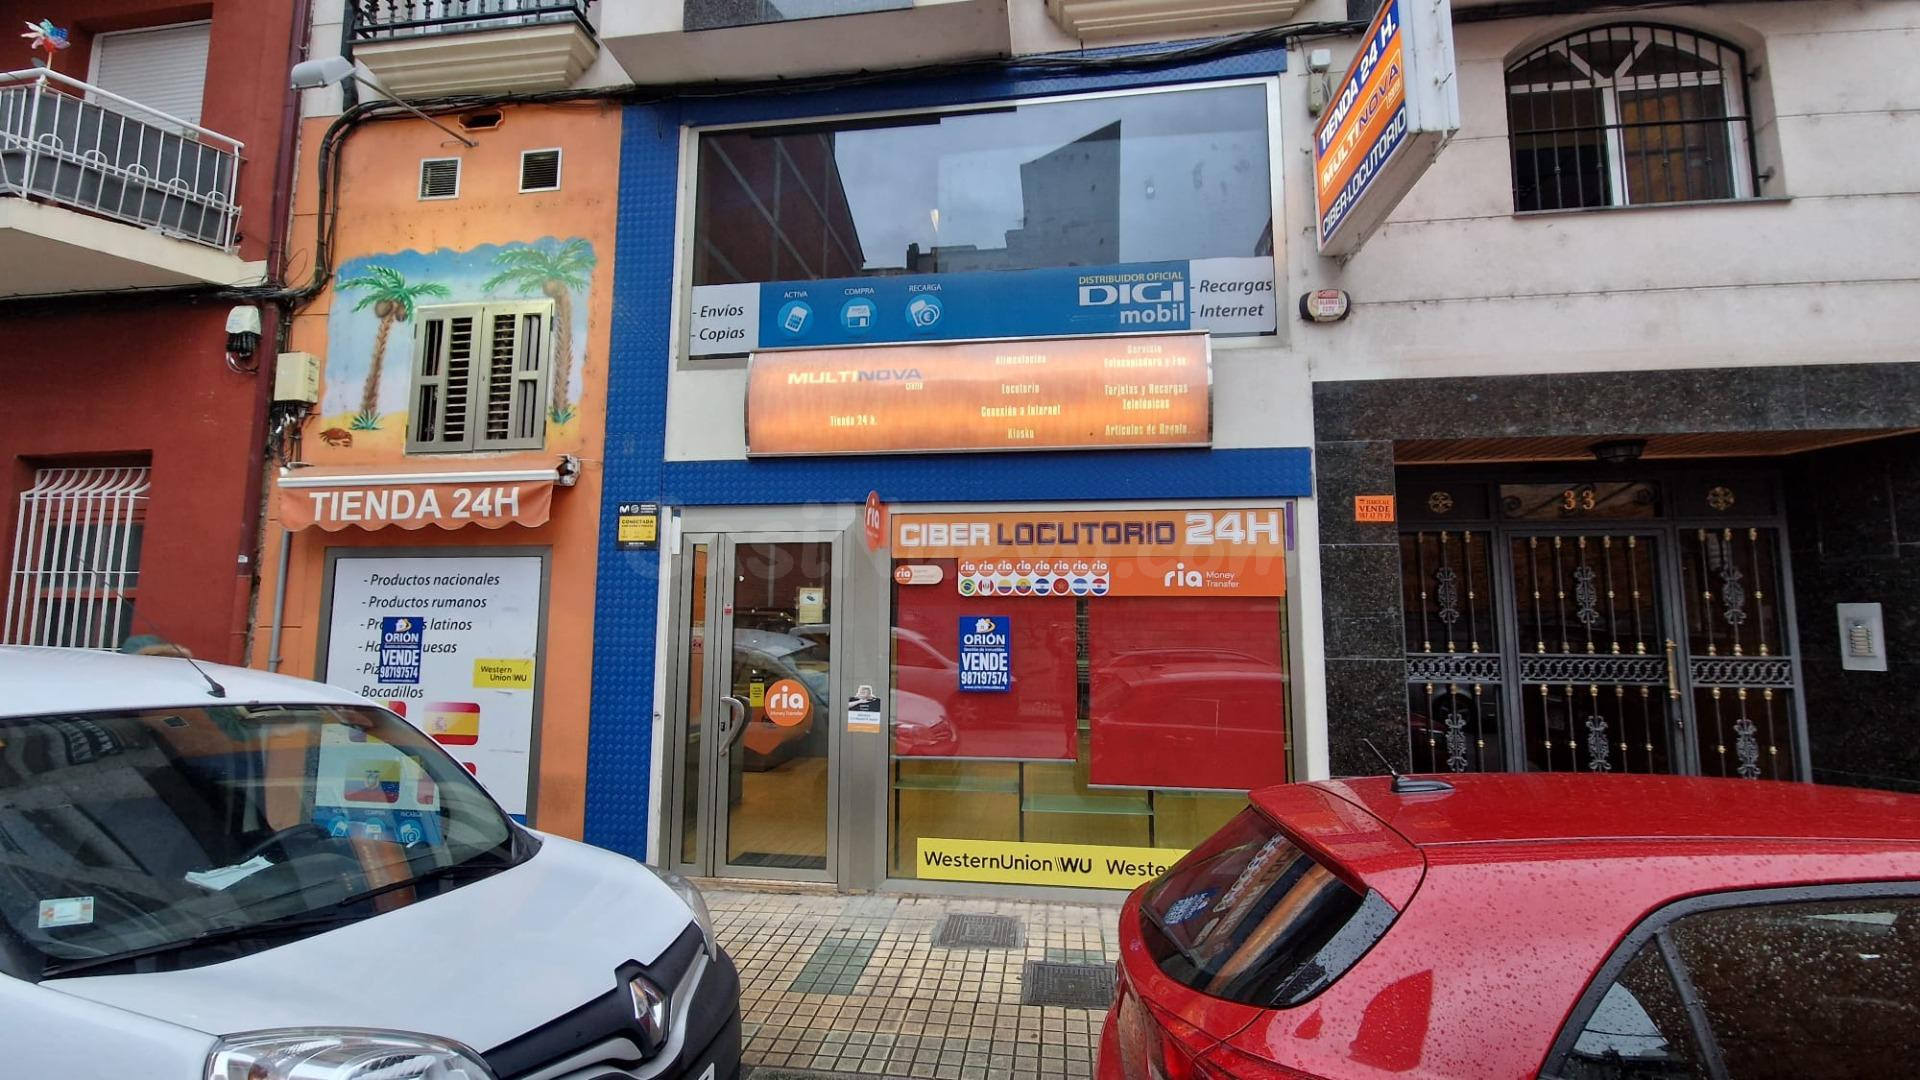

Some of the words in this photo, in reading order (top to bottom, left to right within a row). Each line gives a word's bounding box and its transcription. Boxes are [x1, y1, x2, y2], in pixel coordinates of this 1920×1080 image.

[1319, 83, 1358, 150] TIENDA
[1359, 39, 1378, 80] 24
[1381, 13, 1397, 47] H.
[1322, 62, 1400, 186] MULTINOVA
[1079, 273, 1146, 285] DISTRIBUIDOR
[1146, 272, 1183, 281] OFICIAL
[844, 287, 875, 296] COMPRA
[908, 284, 942, 293] RECARGA
[1200, 279, 1272, 295] Recargas
[784, 291, 808, 299] ACTIVA
[1079, 283, 1185, 306] DIGI
[700, 304, 744, 318] Envíos
[1120, 304, 1185, 324] mobil
[1200, 304, 1264, 318] Internet
[699, 328, 745, 343] Copias
[788, 368, 922, 385] MULTINOVA
[1002, 383, 1040, 394] Locutorio
[1104, 384, 1138, 397] Tarjetas
[1148, 384, 1188, 396] Recargas
[1027, 404, 1061, 416] Internet
[830, 416, 855, 426] Tienda
[857, 415, 868, 425] 24
[1008, 427, 1035, 439] Kiosko
[1146, 424, 1156, 435] de
[309, 489, 442, 521] TIENDA
[451, 487, 519, 518] 24H
[1359, 505, 1391, 513] VENDE
[900, 522, 991, 547] CIBER
[997, 520, 1176, 547] LOCUTORIO
[1184, 511, 1279, 545] 24H
[370, 573, 430, 586] Productos
[433, 573, 500, 586] nacionales
[1164, 562, 1203, 587] ria
[1206, 572, 1235, 580] Money
[1206, 580, 1240, 588] Transfer
[368, 596, 429, 608] Productos
[431, 598, 487, 608] rumanos
[430, 618, 472, 631] latinos
[384, 632, 419, 643] ORIÓN
[963, 633, 1005, 645] ORIÓN
[382, 649, 420, 666] VENDE
[961, 652, 1008, 671] VENDE
[380, 666, 418, 679] 987197574
[480, 666, 512, 674] Western
[961, 671, 1008, 685] 987197574
[361, 685, 424, 698] Bocadillos
[770, 685, 804, 709] ria
[924, 851, 1053, 872] WesternUnion
[1106, 859, 1170, 877] Weste
